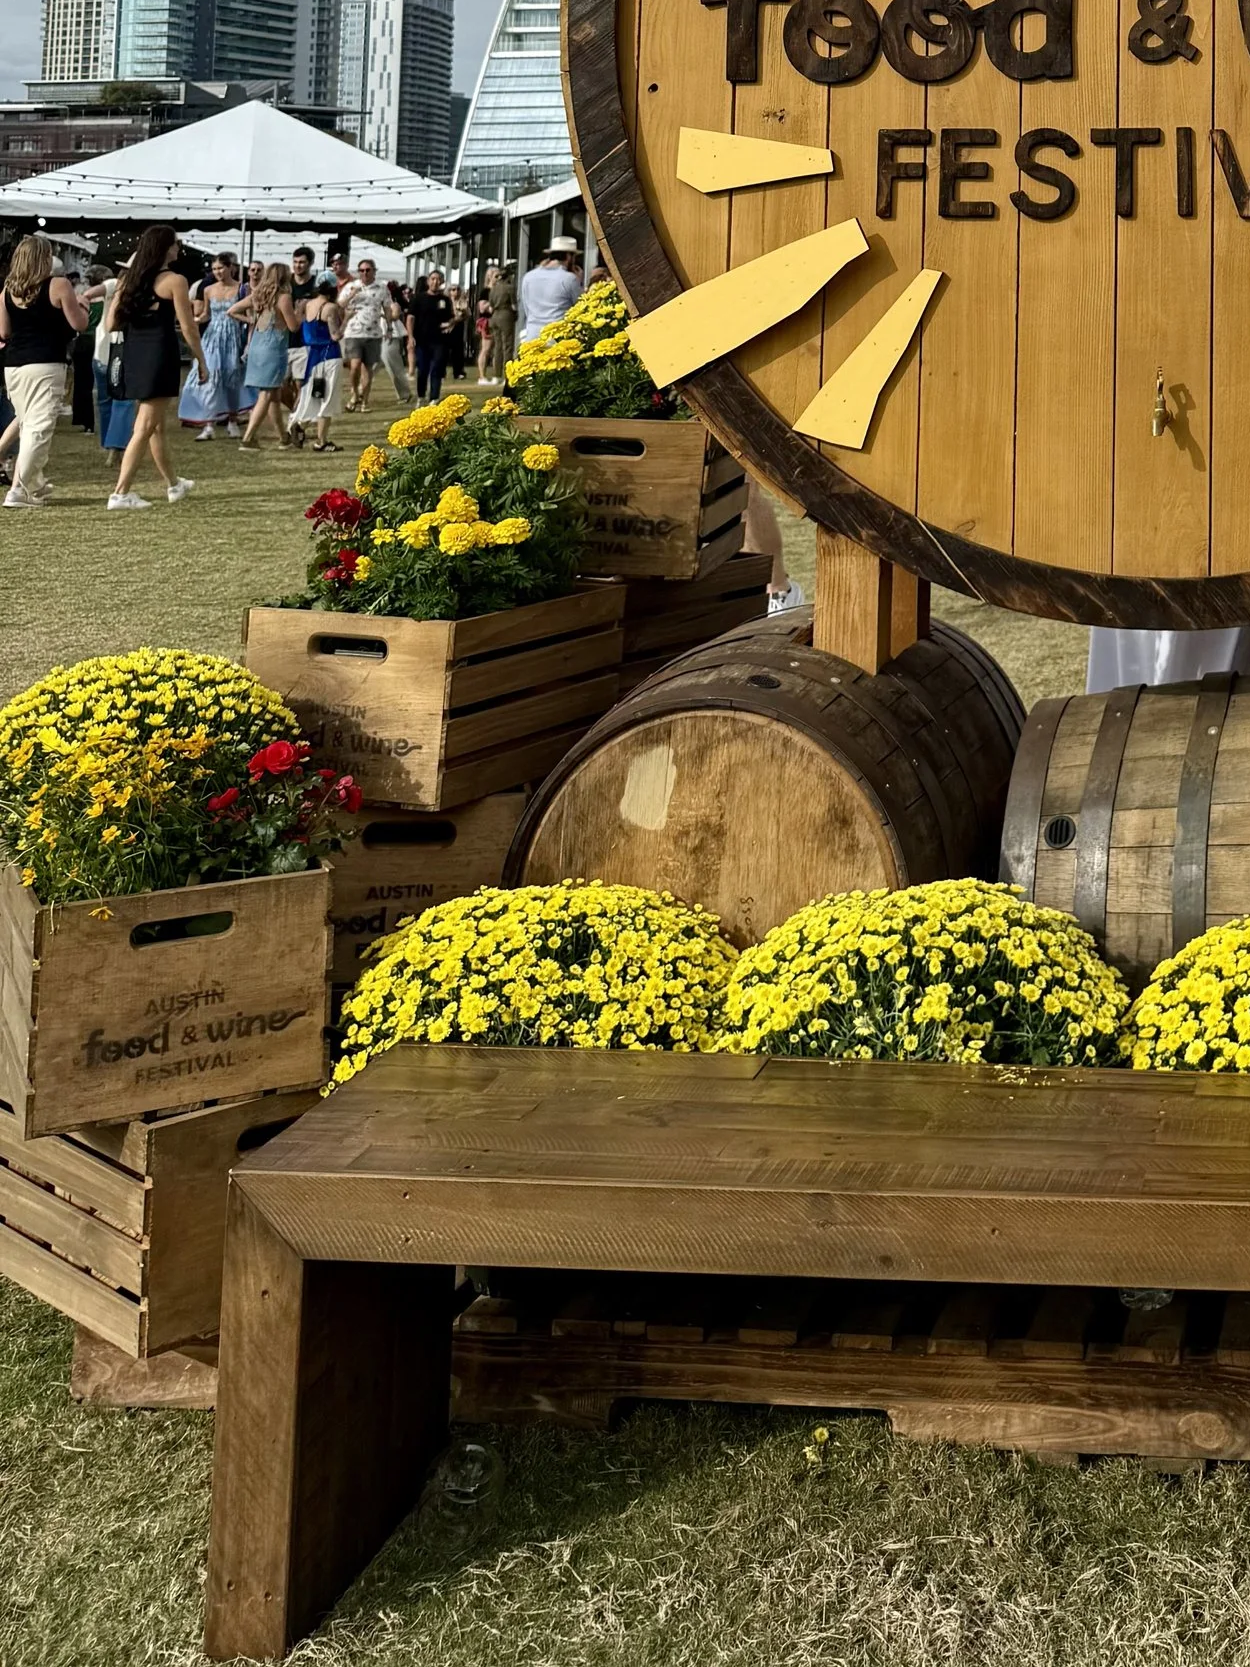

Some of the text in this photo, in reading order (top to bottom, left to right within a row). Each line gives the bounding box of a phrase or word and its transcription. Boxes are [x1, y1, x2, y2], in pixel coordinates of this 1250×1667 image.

[584, 492, 629, 507] USTIN
[332, 730, 344, 748] &
[351, 730, 423, 757] wine
[365, 884, 434, 901] AUSTIN
[333, 907, 387, 934] ood
[144, 987, 226, 1017] AUSTIN
[81, 1009, 307, 1069] food & wine
[135, 1050, 237, 1084] FESTIVAL
